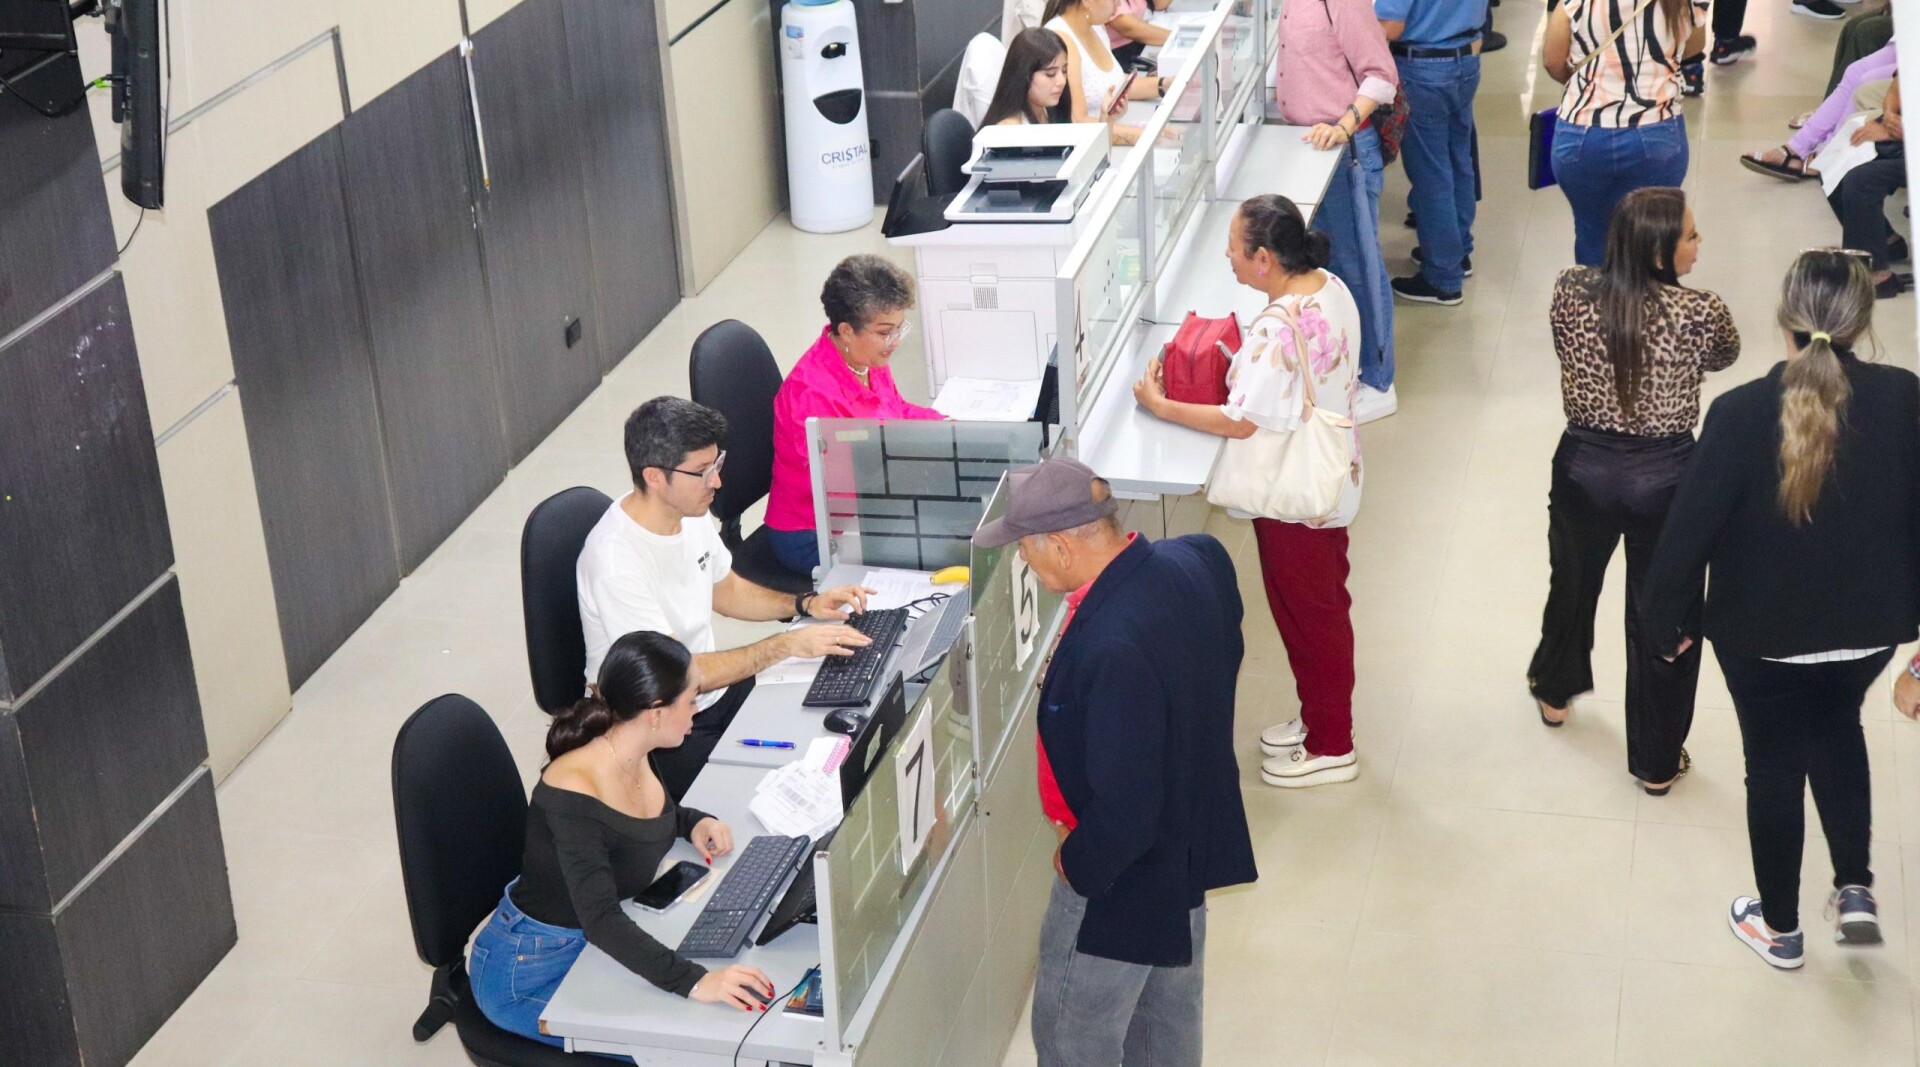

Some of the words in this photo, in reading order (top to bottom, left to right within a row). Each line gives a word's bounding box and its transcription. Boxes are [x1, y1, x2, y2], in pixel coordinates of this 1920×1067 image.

[821, 143, 868, 165] CRISTAL
[1075, 289, 1085, 362] 4
[1020, 562, 1033, 645] 5
[905, 740, 924, 844] 7
